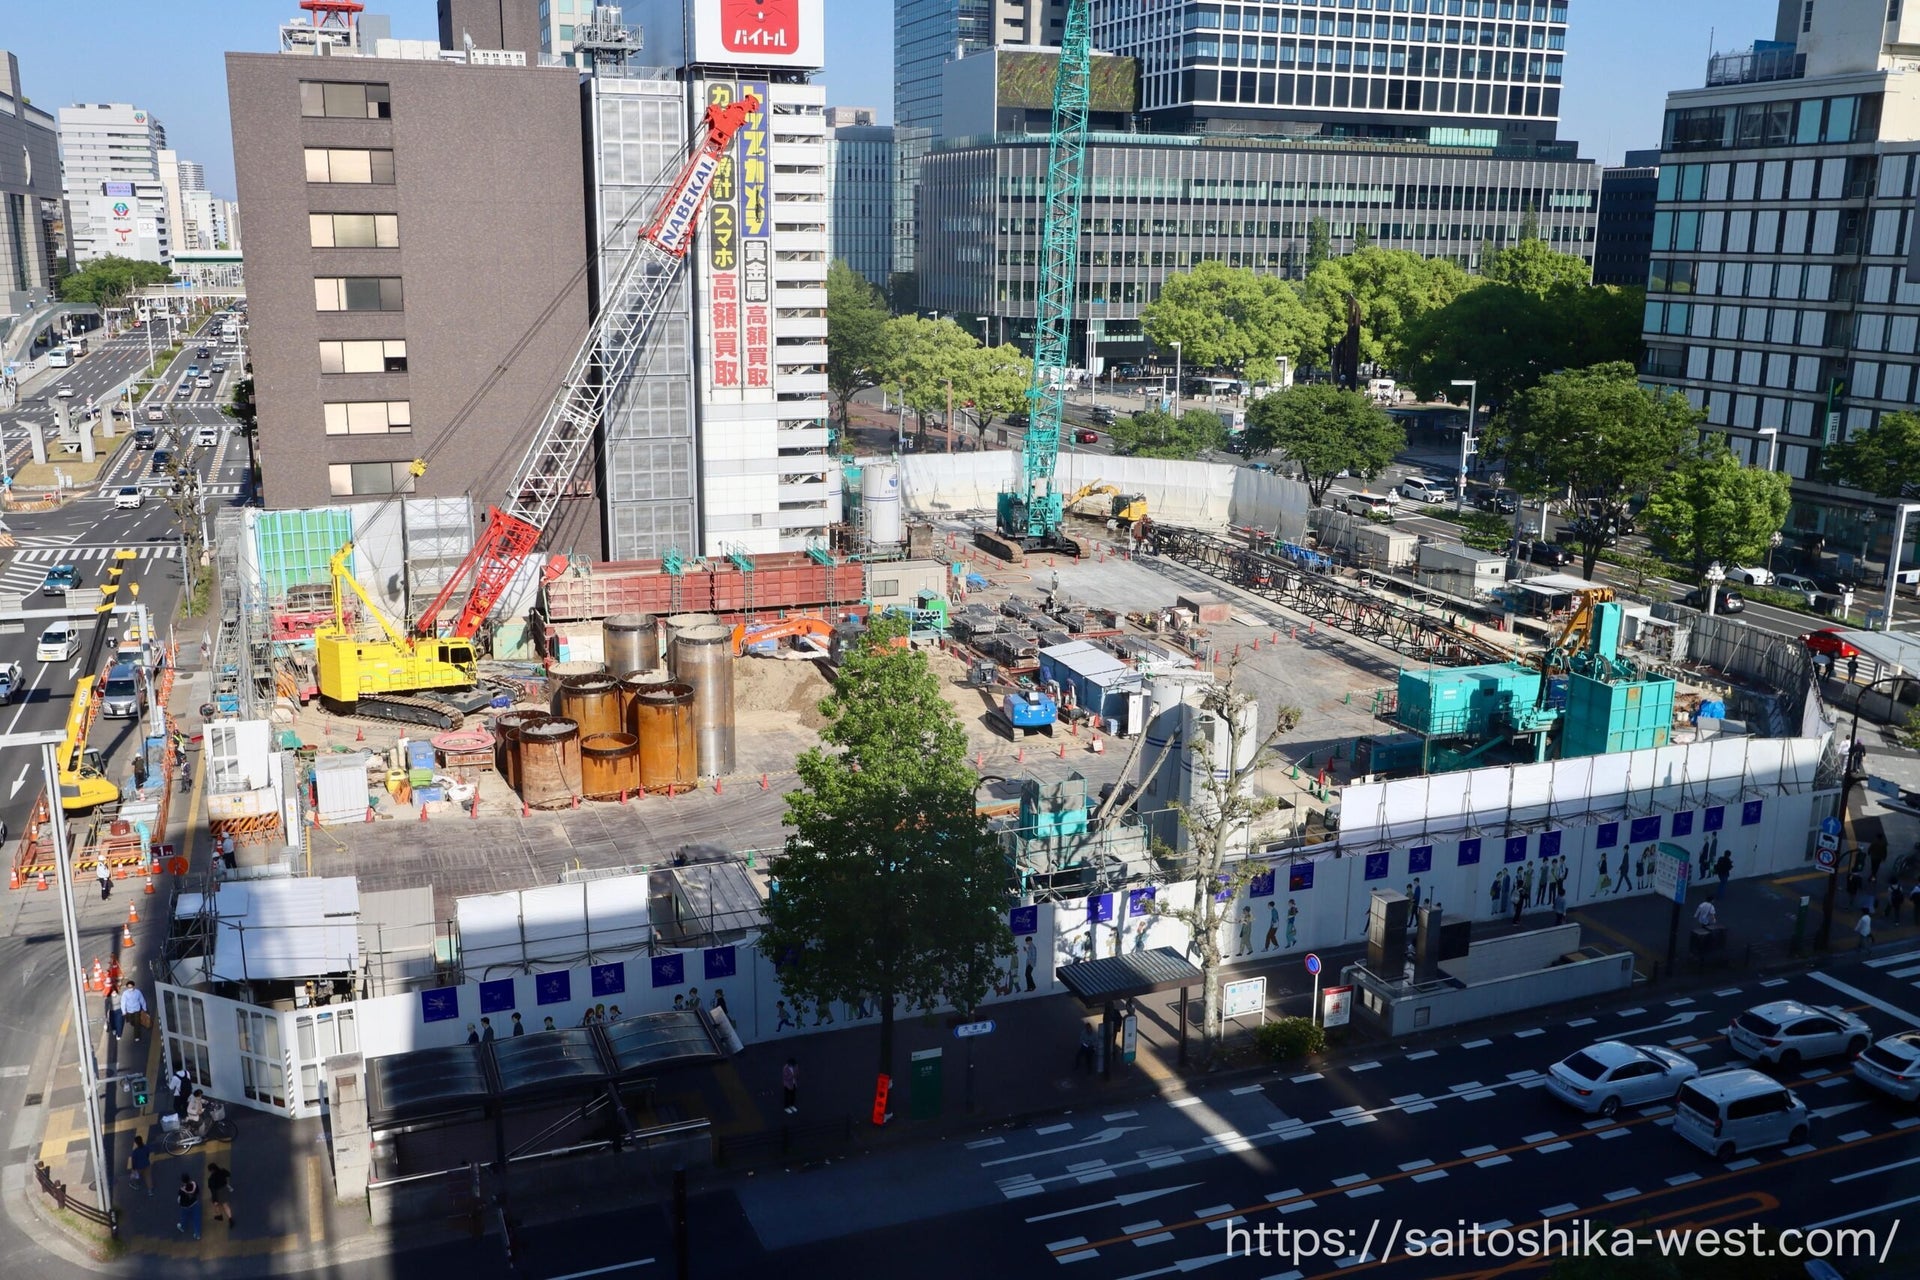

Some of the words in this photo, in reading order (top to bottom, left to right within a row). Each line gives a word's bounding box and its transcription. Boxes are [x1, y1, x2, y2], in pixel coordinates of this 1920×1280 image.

[734, 28, 787, 47] バイトル
[714, 208, 734, 267] スマホ
[745, 241, 767, 300] 貴金属
[712, 273, 738, 387] 高額買取
[746, 306, 768, 387] 高額買取
[1829, 415, 1839, 445] 三井住
